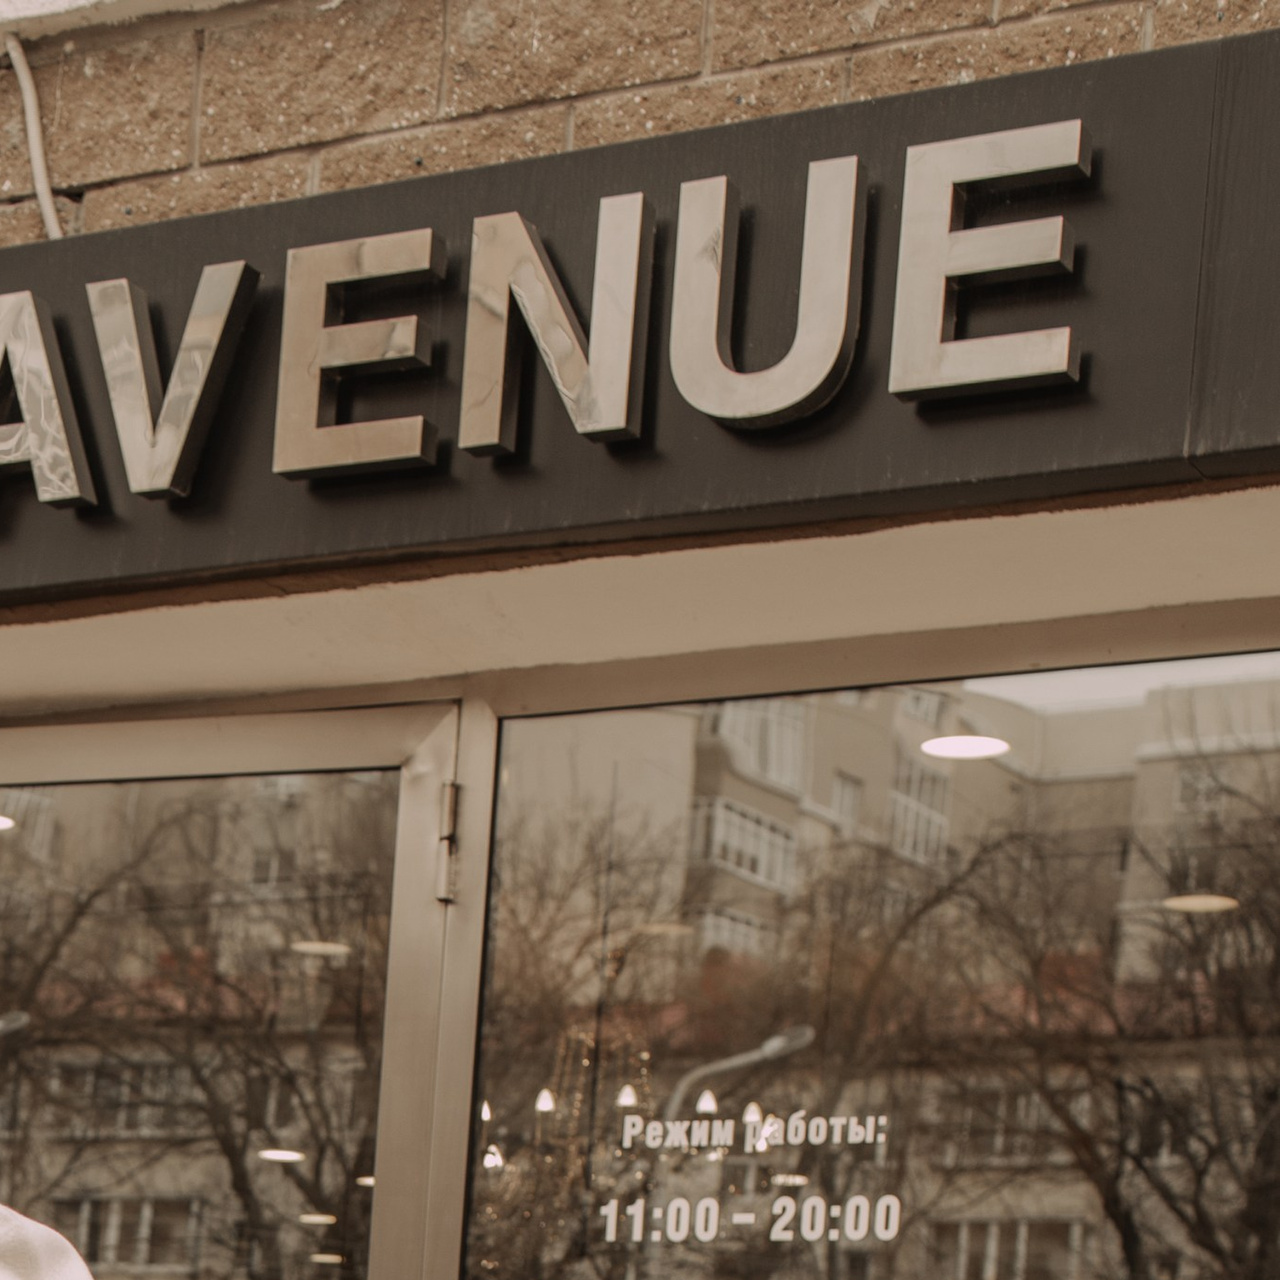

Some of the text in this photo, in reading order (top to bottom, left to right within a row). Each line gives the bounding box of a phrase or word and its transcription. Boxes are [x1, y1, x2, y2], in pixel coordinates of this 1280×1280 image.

[621, 1109, 889, 1153] Режим работы:
[599, 1196, 721, 1243] 11:00
[769, 1194, 902, 1243] 20:00
